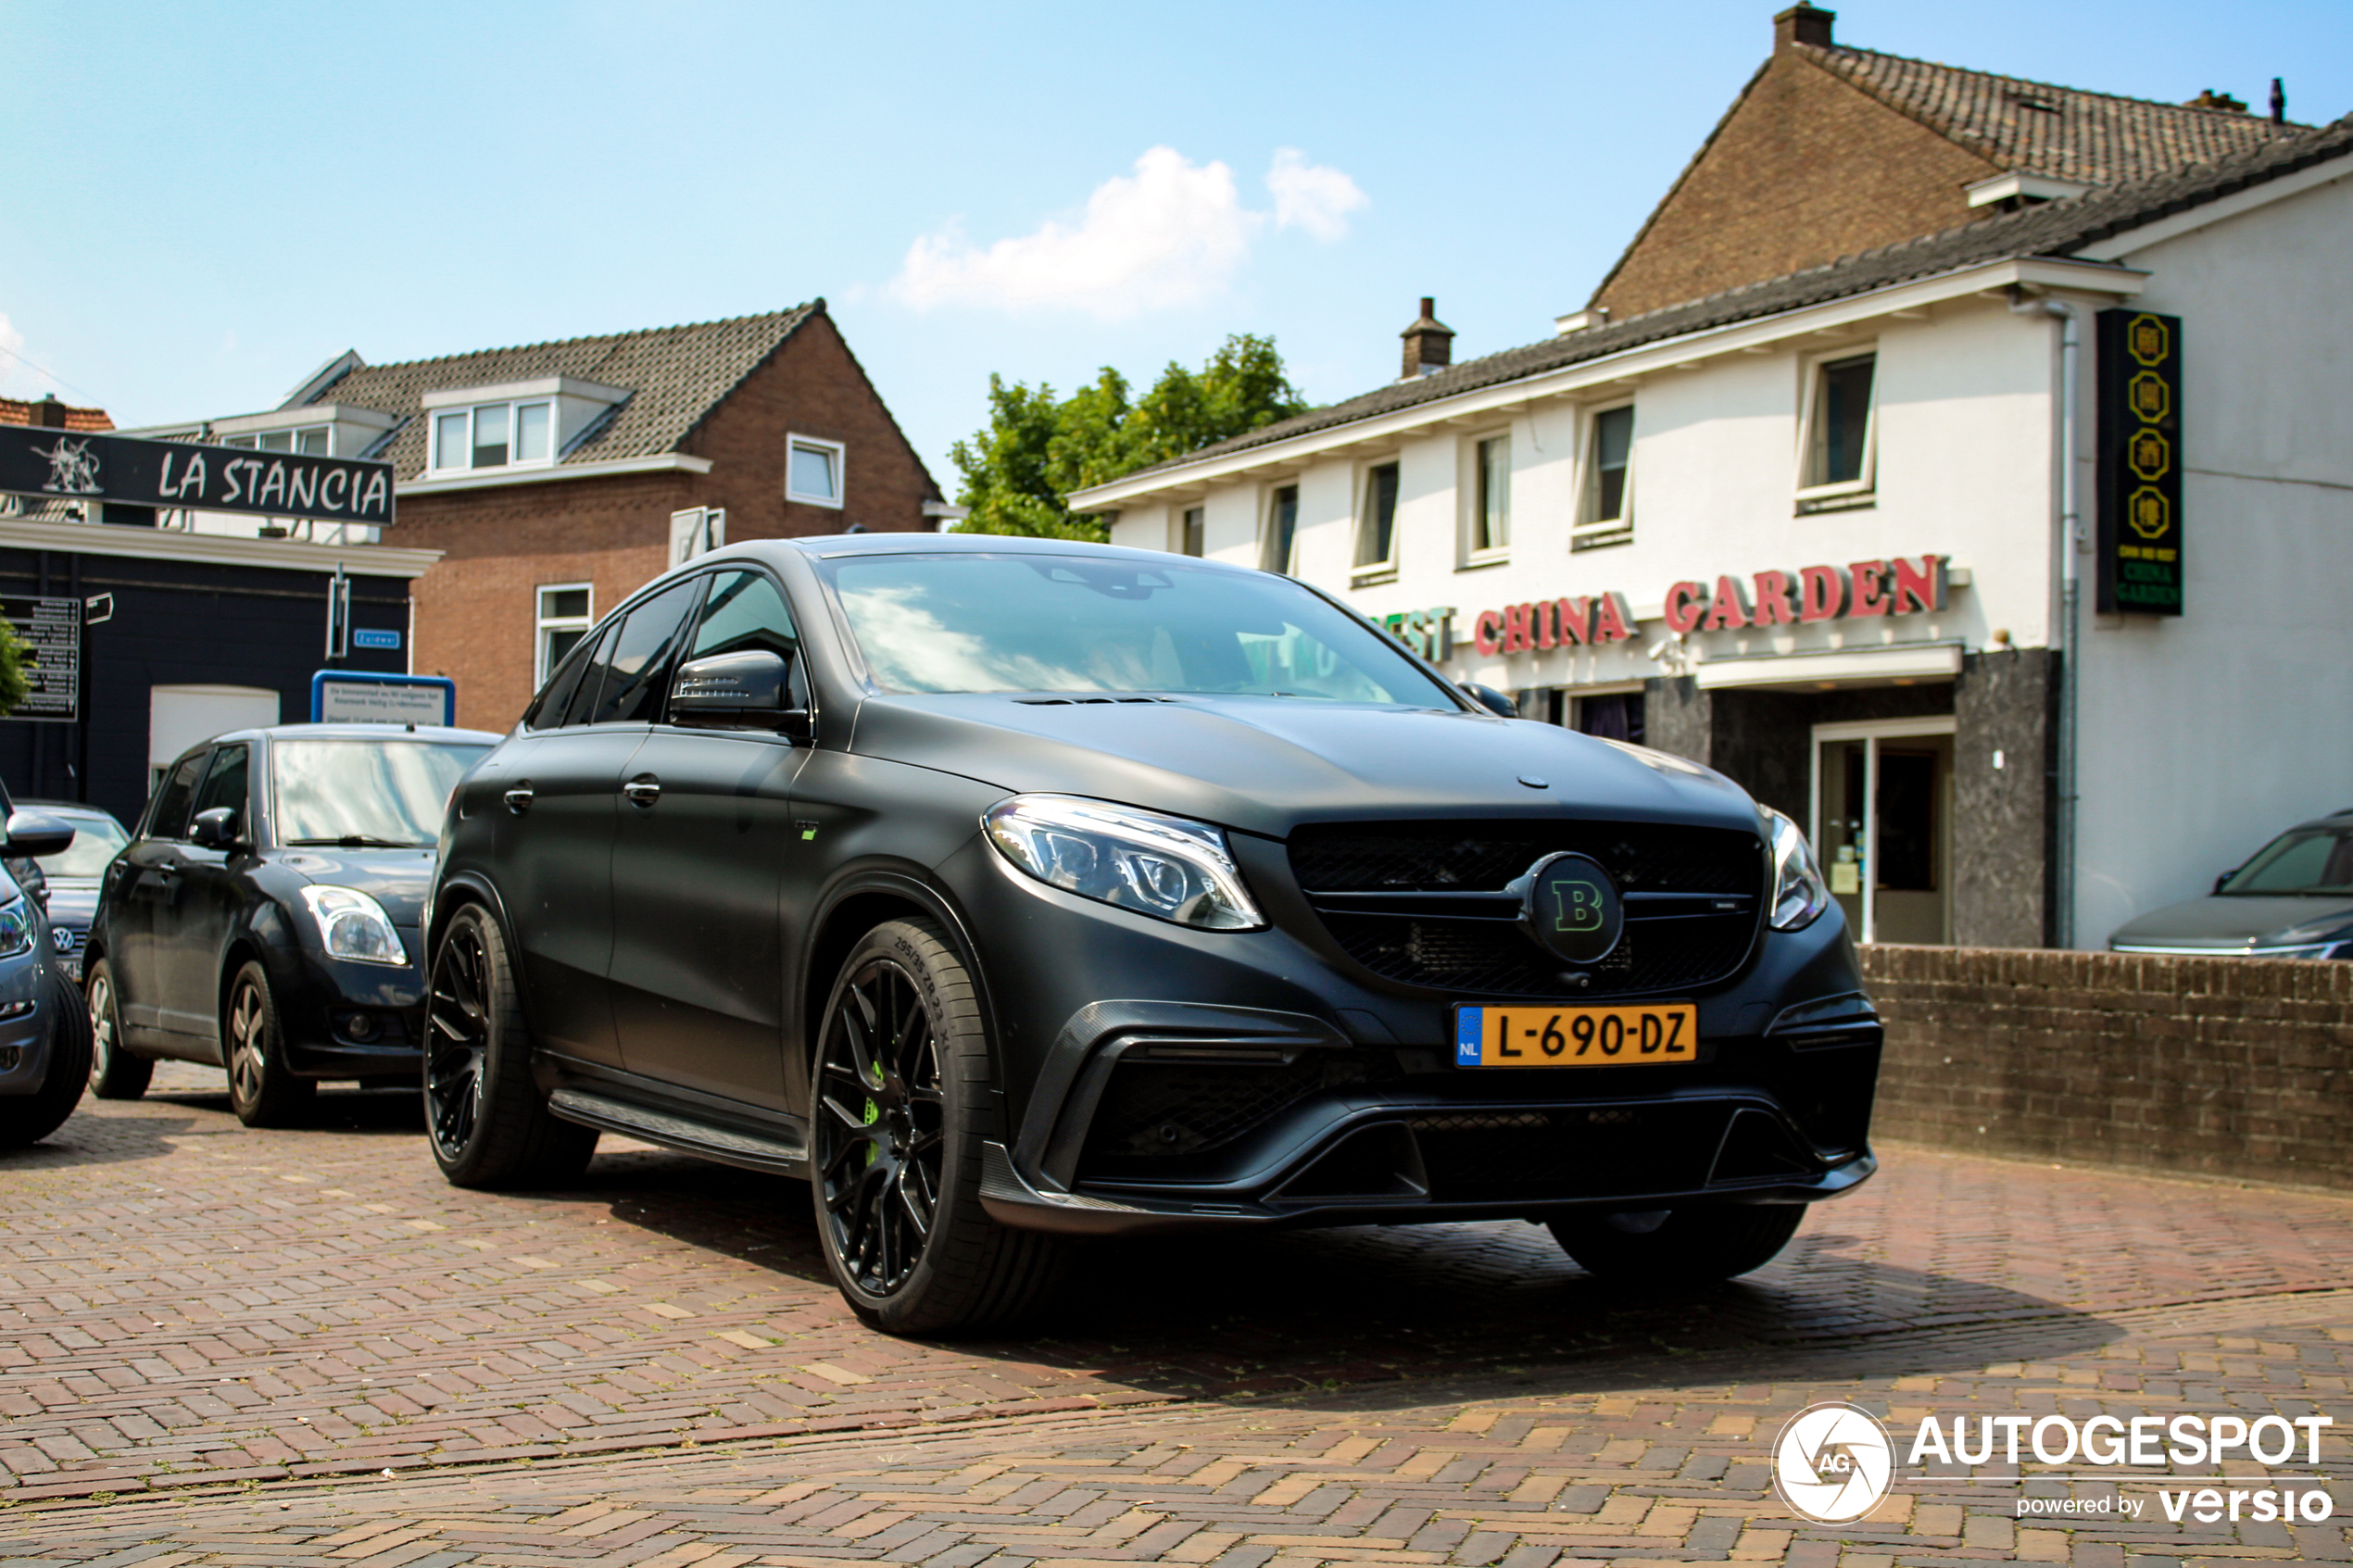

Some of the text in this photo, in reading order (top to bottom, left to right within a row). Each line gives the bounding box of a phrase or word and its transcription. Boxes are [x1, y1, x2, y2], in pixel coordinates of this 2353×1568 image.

[158, 451, 387, 515] LA STANCIA
[1368, 608, 1452, 662] EST
[1474, 592, 1636, 656] CHINA
[1665, 555, 1945, 632] GARDEN
[1552, 880, 1604, 932] B
[894, 936, 925, 973] 295/35
[923, 972, 936, 997] ZR
[932, 997, 944, 1022] 23
[1460, 1012, 1686, 1058] NL L-690-DZ
